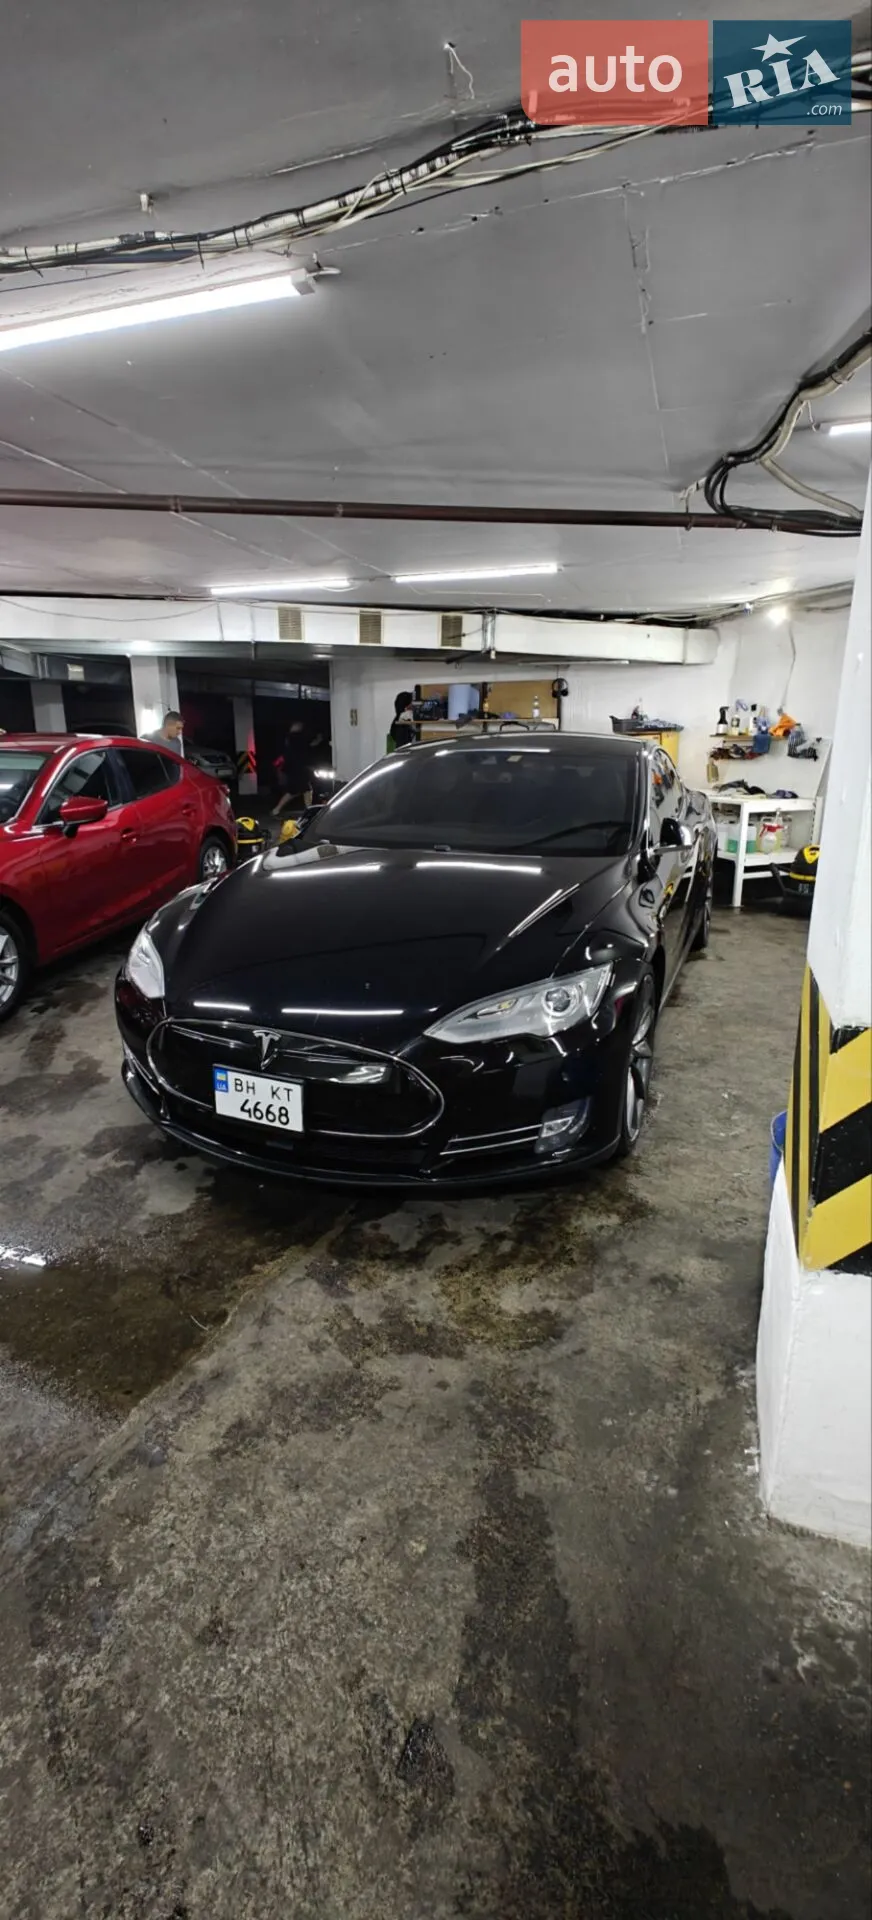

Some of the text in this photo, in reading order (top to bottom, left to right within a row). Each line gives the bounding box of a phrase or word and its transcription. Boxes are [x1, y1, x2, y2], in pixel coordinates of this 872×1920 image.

[234, 1078, 293, 1102] BH KT
[240, 1098, 290, 1126] 4668
